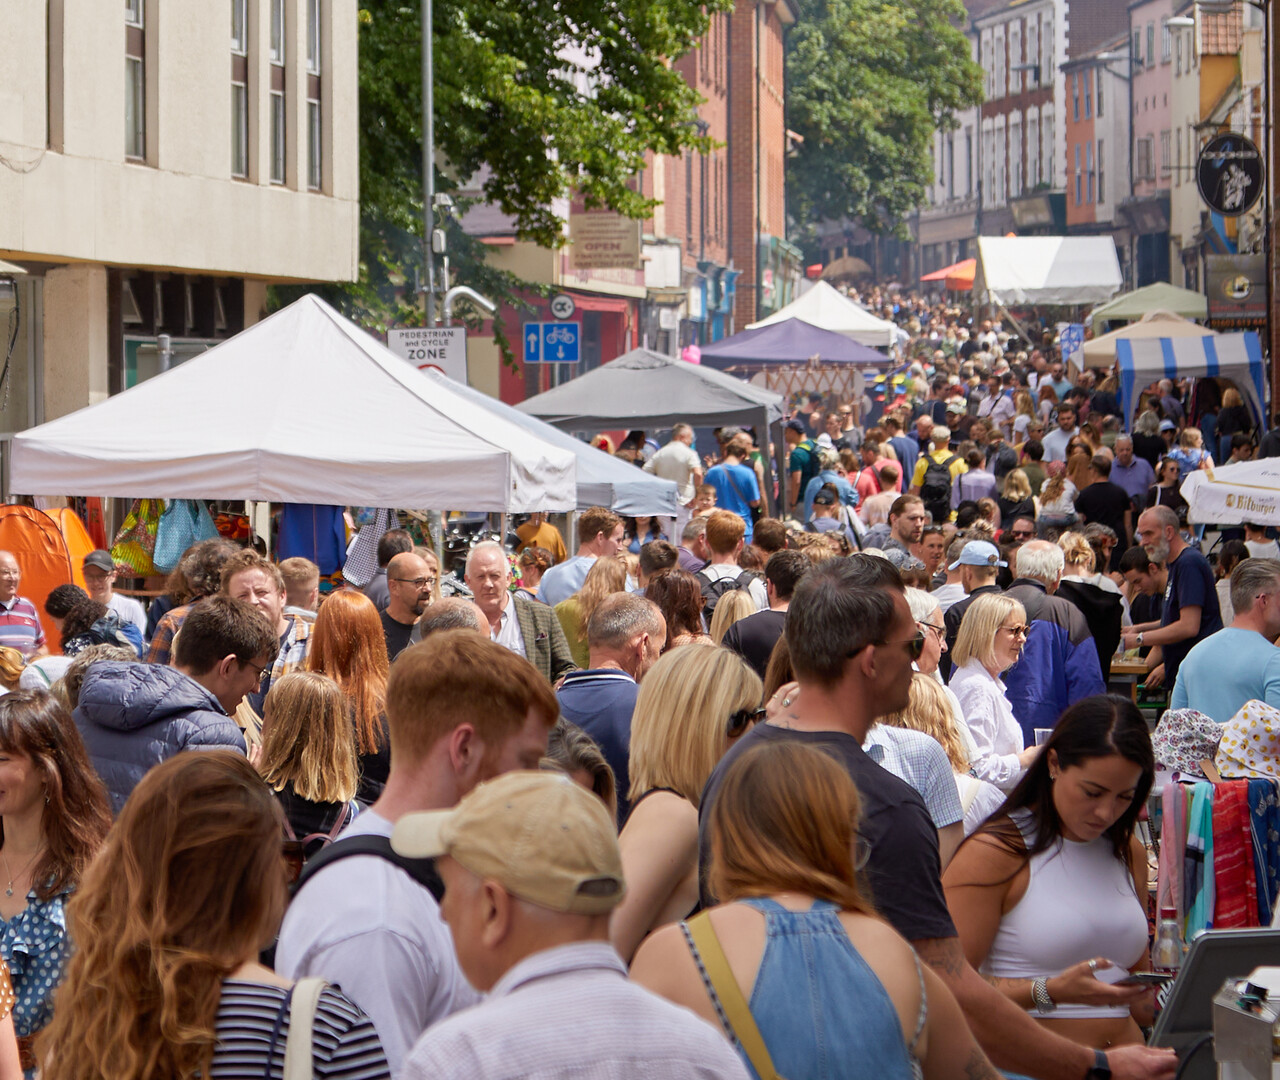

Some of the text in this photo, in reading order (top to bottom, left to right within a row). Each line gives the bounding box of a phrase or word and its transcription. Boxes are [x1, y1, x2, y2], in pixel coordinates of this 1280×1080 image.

[584, 242, 622, 252] OPEN
[399, 330, 455, 339] PEDESTRIAN
[421, 339, 450, 347] CYCLE
[408, 348, 447, 360] ZONE
[1235, 494, 1276, 515] Bitburger
